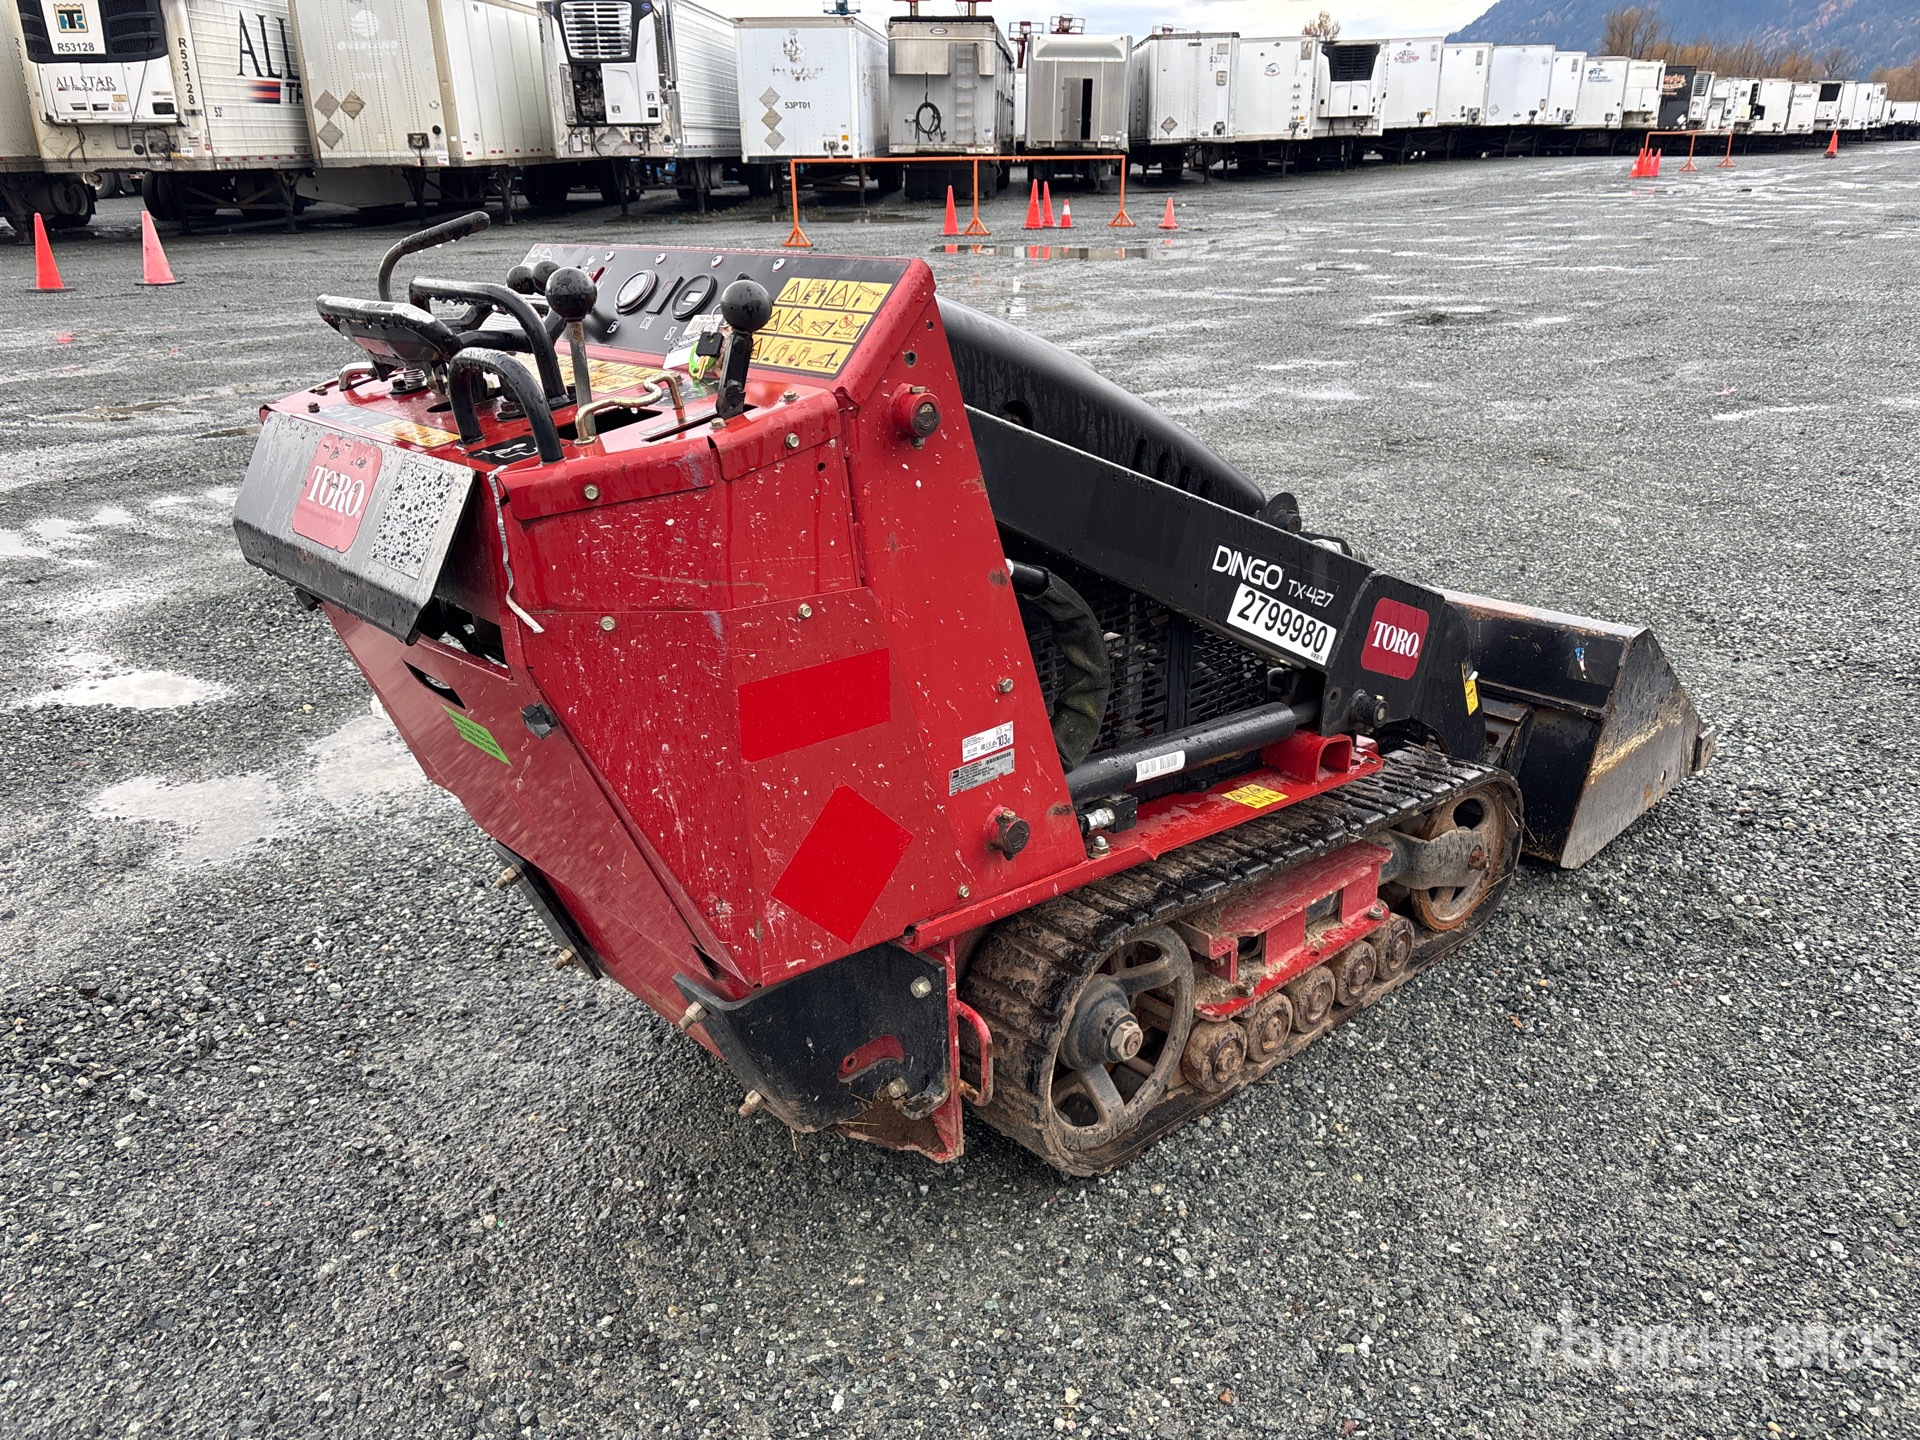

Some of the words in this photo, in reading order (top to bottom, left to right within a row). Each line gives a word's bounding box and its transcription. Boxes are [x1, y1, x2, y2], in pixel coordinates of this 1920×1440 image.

[57, 42, 95, 52] R53128
[236, 9, 301, 80] ALL
[56, 75, 78, 88] ALL
[80, 75, 116, 88] STAR
[178, 37, 196, 105] R53128
[784, 101, 811, 109] 53PT01
[307, 465, 365, 517] TORO
[1211, 545, 1284, 591] DINGO
[1236, 589, 1329, 653] 2799980
[1371, 620, 1420, 657] TORO
[996, 733, 1008, 746] 103
